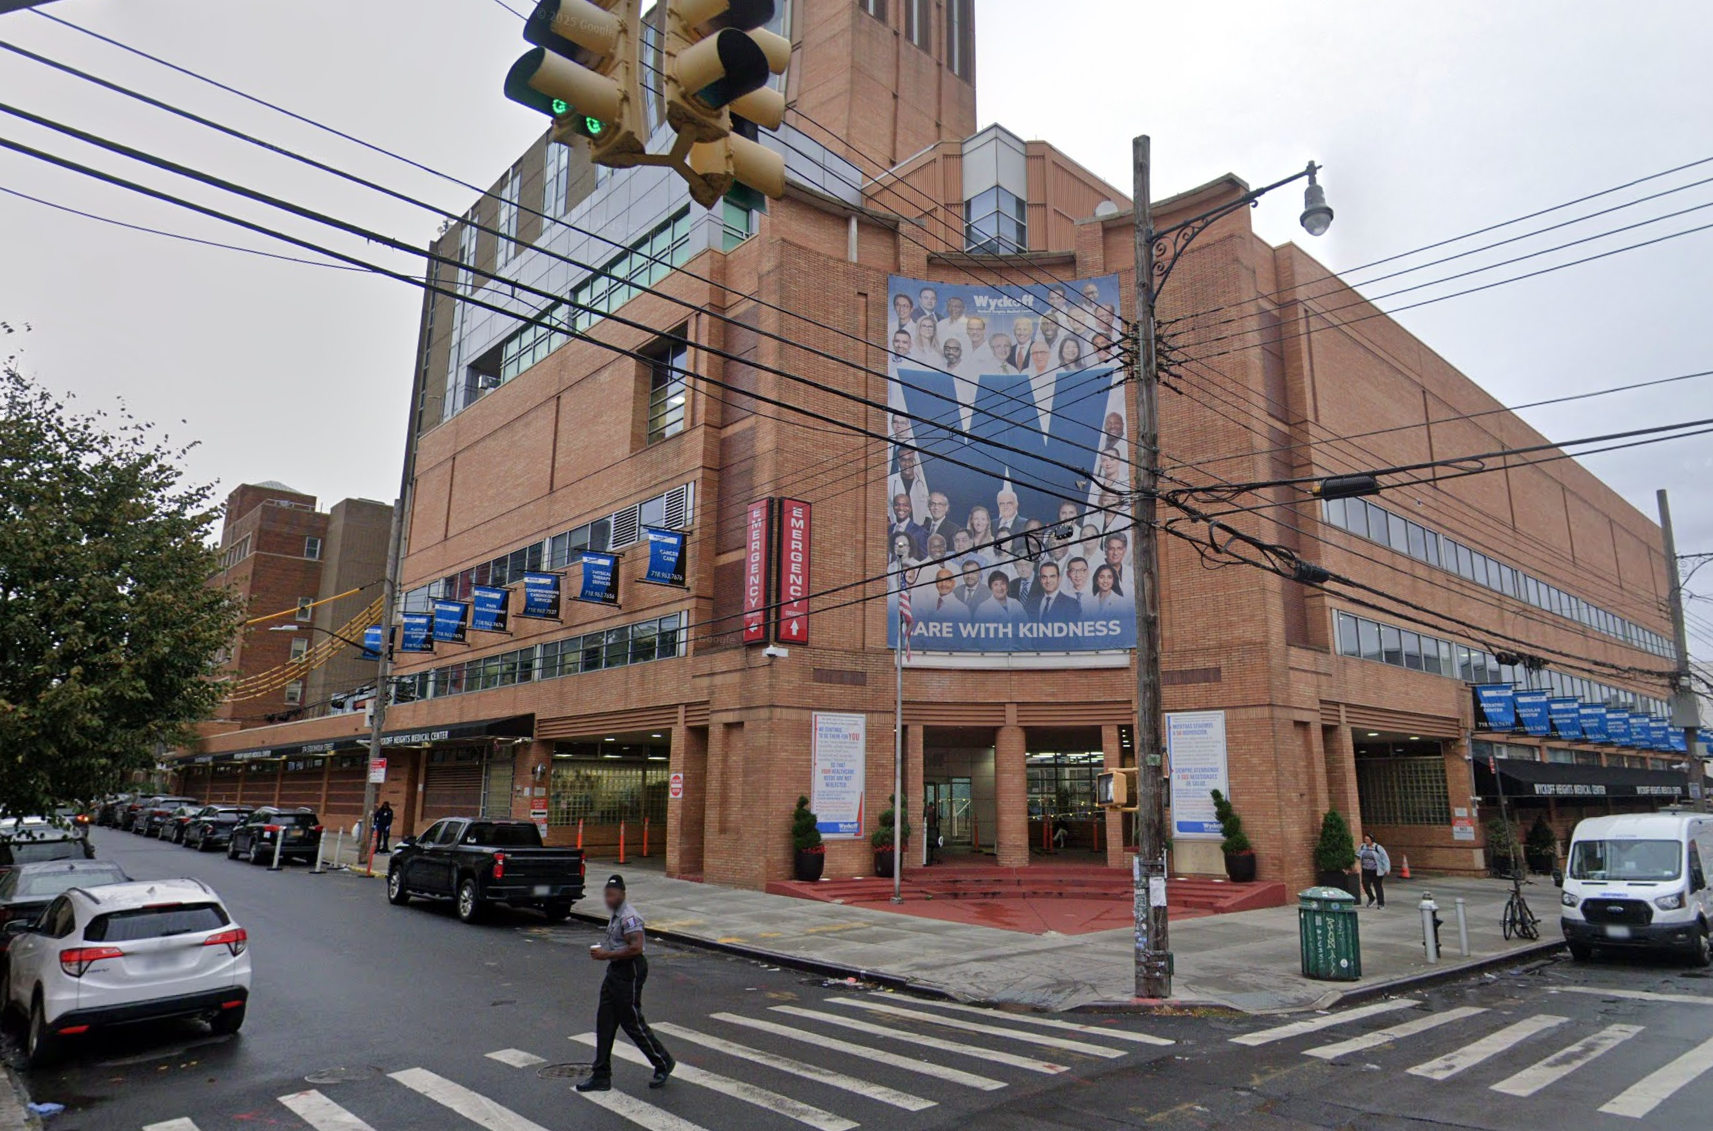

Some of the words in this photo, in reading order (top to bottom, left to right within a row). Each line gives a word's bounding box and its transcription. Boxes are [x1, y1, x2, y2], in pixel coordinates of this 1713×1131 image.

[974, 294, 1034, 310] Wyckoff
[750, 508, 762, 608] EMERGENCY
[790, 506, 804, 608] EMERGENCY
[903, 621, 953, 638] ARE
[958, 622, 1012, 638] WITH
[1018, 620, 1122, 638] KINDNESS
[394, 735, 410, 744] HEIGHTS
[411, 733, 430, 742] MEDICAL
[431, 731, 449, 740] CENTER
[1574, 785, 1592, 794] MEDICAL
[1592, 785, 1606, 794] CENTER
